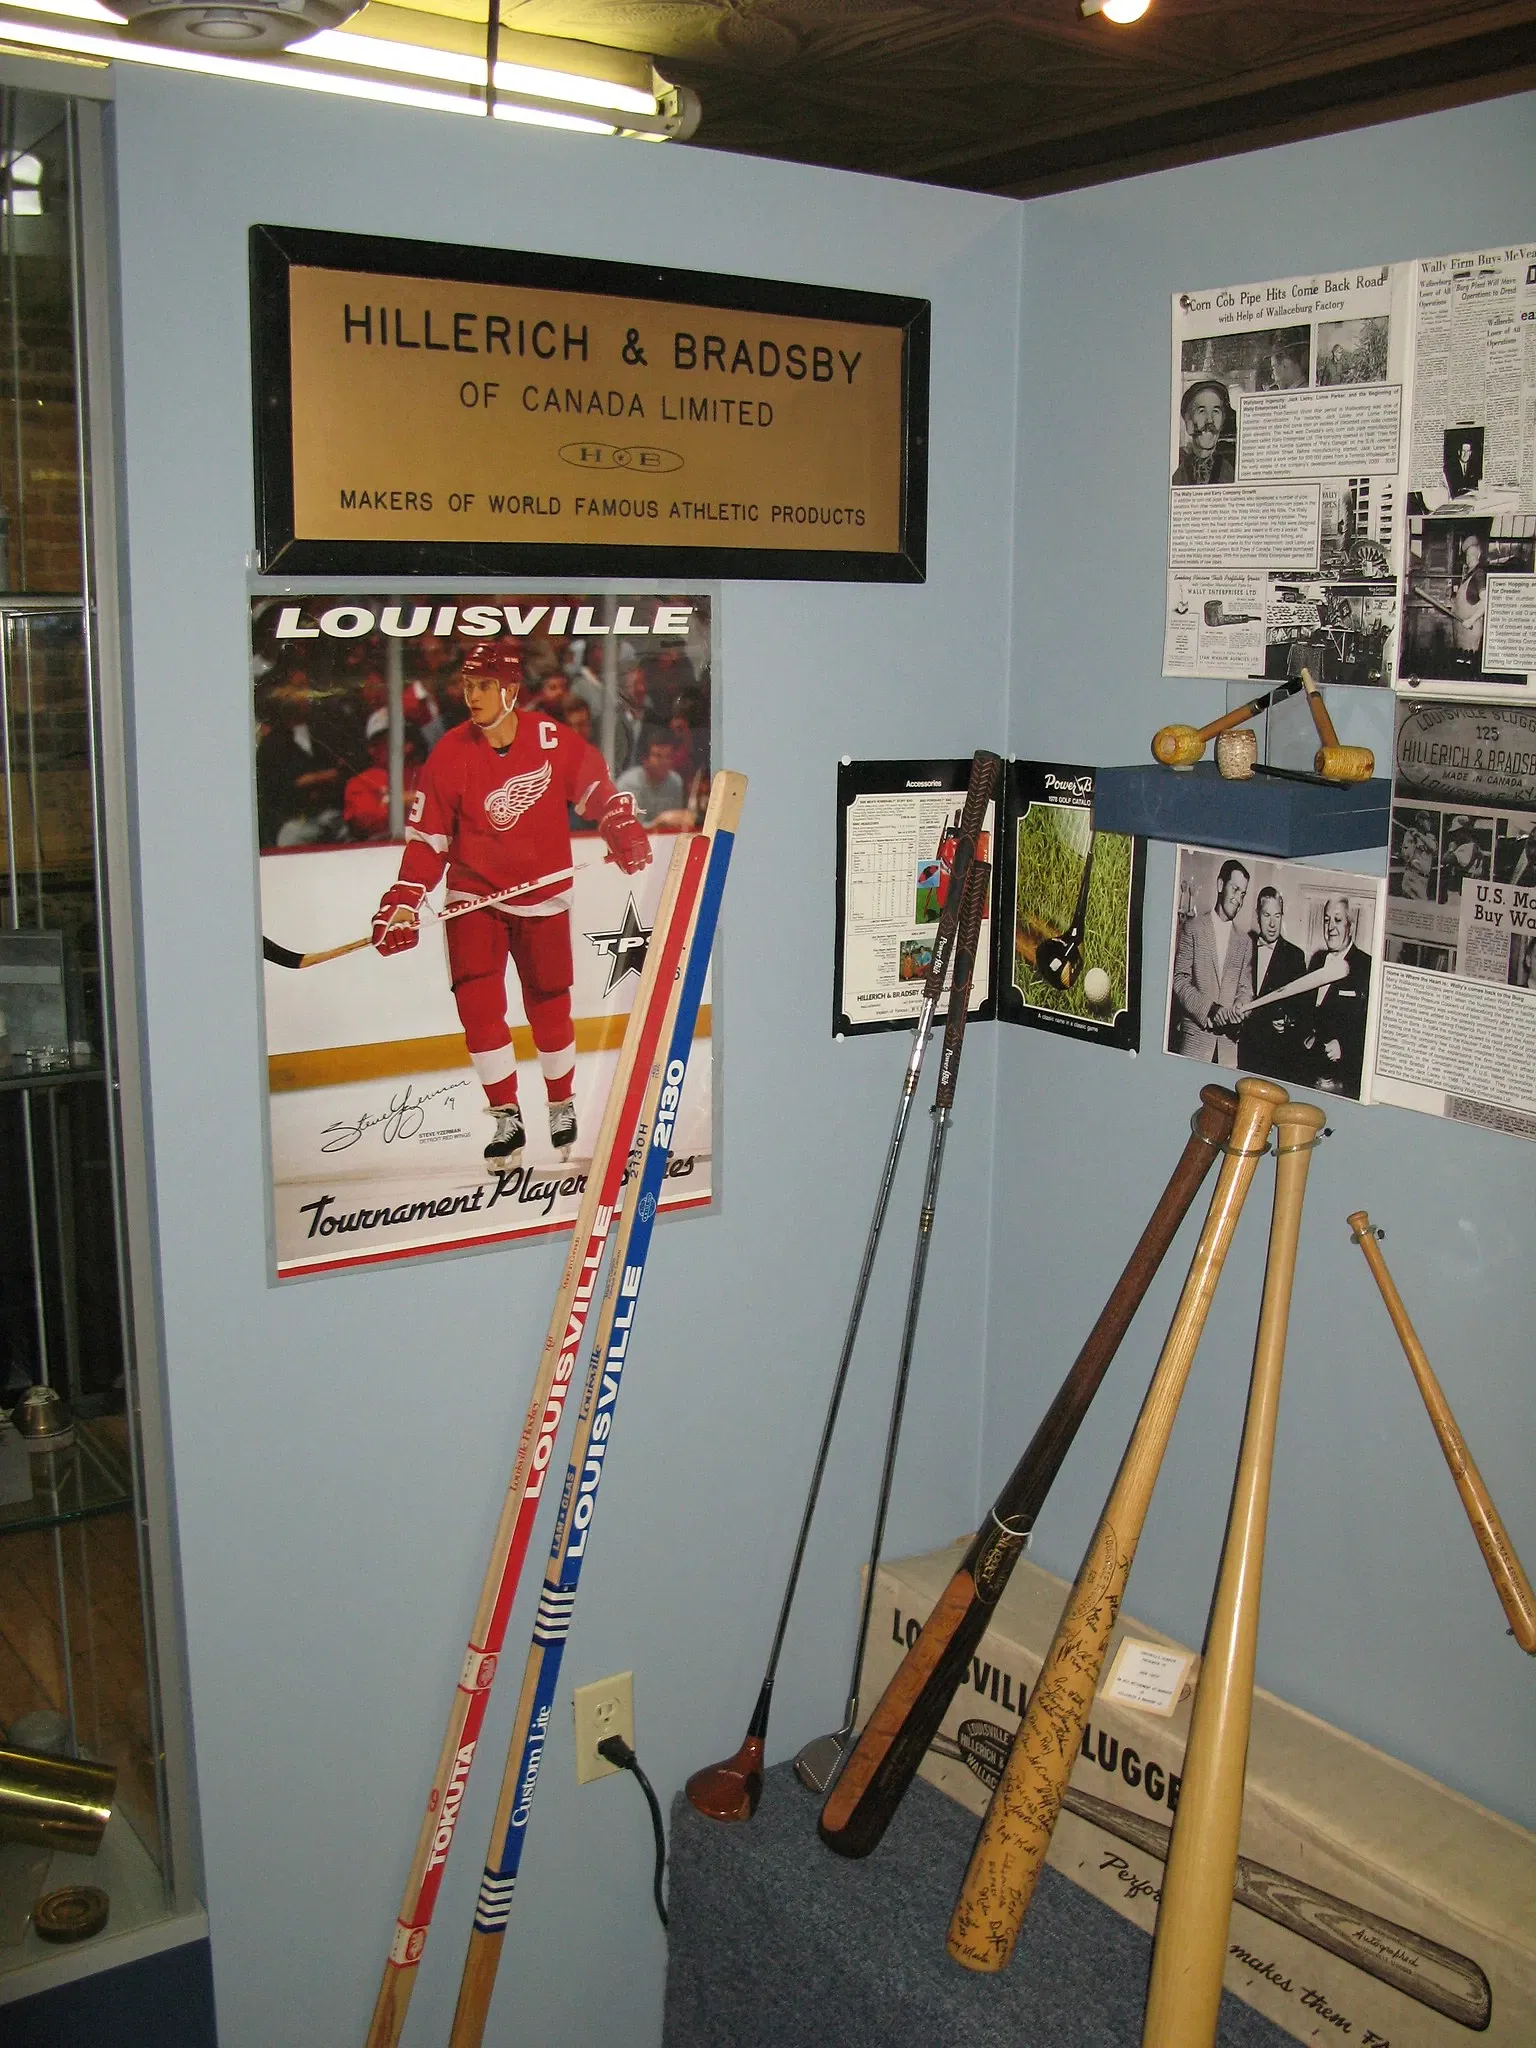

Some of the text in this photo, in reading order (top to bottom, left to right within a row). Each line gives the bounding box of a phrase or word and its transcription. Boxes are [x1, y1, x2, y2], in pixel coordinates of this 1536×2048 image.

[1421, 261, 1447, 274] Wally
[1450, 258, 1474, 269] Firm
[1478, 254, 1501, 265] Buys
[1190, 273, 1384, 311] Corn Cob Pipe Hits Come Back Road
[1218, 300, 1345, 323] with Help of Wallaceburg Factory
[344, 303, 863, 385] HILLERICH & BRADSBY
[459, 381, 774, 428] OF CANADA LIMITED
[340, 489, 866, 527] MAKERS OF WORLD FAMOUS ATHLETIC PRODUCTS
[275, 605, 695, 640] LOUISVILLE
[539, 721, 558, 750] C
[1416, 709, 1487, 732] LOUISVILLE
[1476, 725, 1500, 741] 125
[1402, 740, 1470, 768] HILLERICH
[1474, 748, 1483, 770] &
[905, 779, 942, 788] Accessories
[1442, 771, 1469, 781] MADE
[1487, 776, 1523, 787] CANADA
[1072, 798, 1091, 806] CATALO
[437, 878, 540, 919] LOUISVILLE
[1477, 885, 1506, 905] U.S.
[1474, 904, 1503, 927] Buy
[592, 935, 652, 956] TP
[857, 993, 886, 1002] HILLERICH
[892, 989, 920, 999] BRADSBY
[653, 1059, 685, 1149] 2130
[418, 1127, 462, 1139] STEVE YZERMAN
[419, 1136, 441, 1145] DETROIT
[299, 1185, 485, 1240] Tournament
[525, 1205, 614, 1498] LOUISVILLE
[567, 1266, 643, 1557] LOUISVILLE
[553, 1344, 602, 1551] LAM GLAS Louisville
[960, 1734, 996, 1764] HILLERICH
[968, 1723, 1009, 1745] LOUISVILLE
[512, 1704, 552, 1827] Custom Lite
[966, 1753, 998, 1789] WALLAC
[1081, 1723, 1182, 1812] LUGGE
[427, 1740, 477, 1871] TOKUTA
[1352, 1929, 1419, 1967] Autographed
[1229, 1944, 1293, 1993] makes
[1300, 1986, 1352, 2033] them
